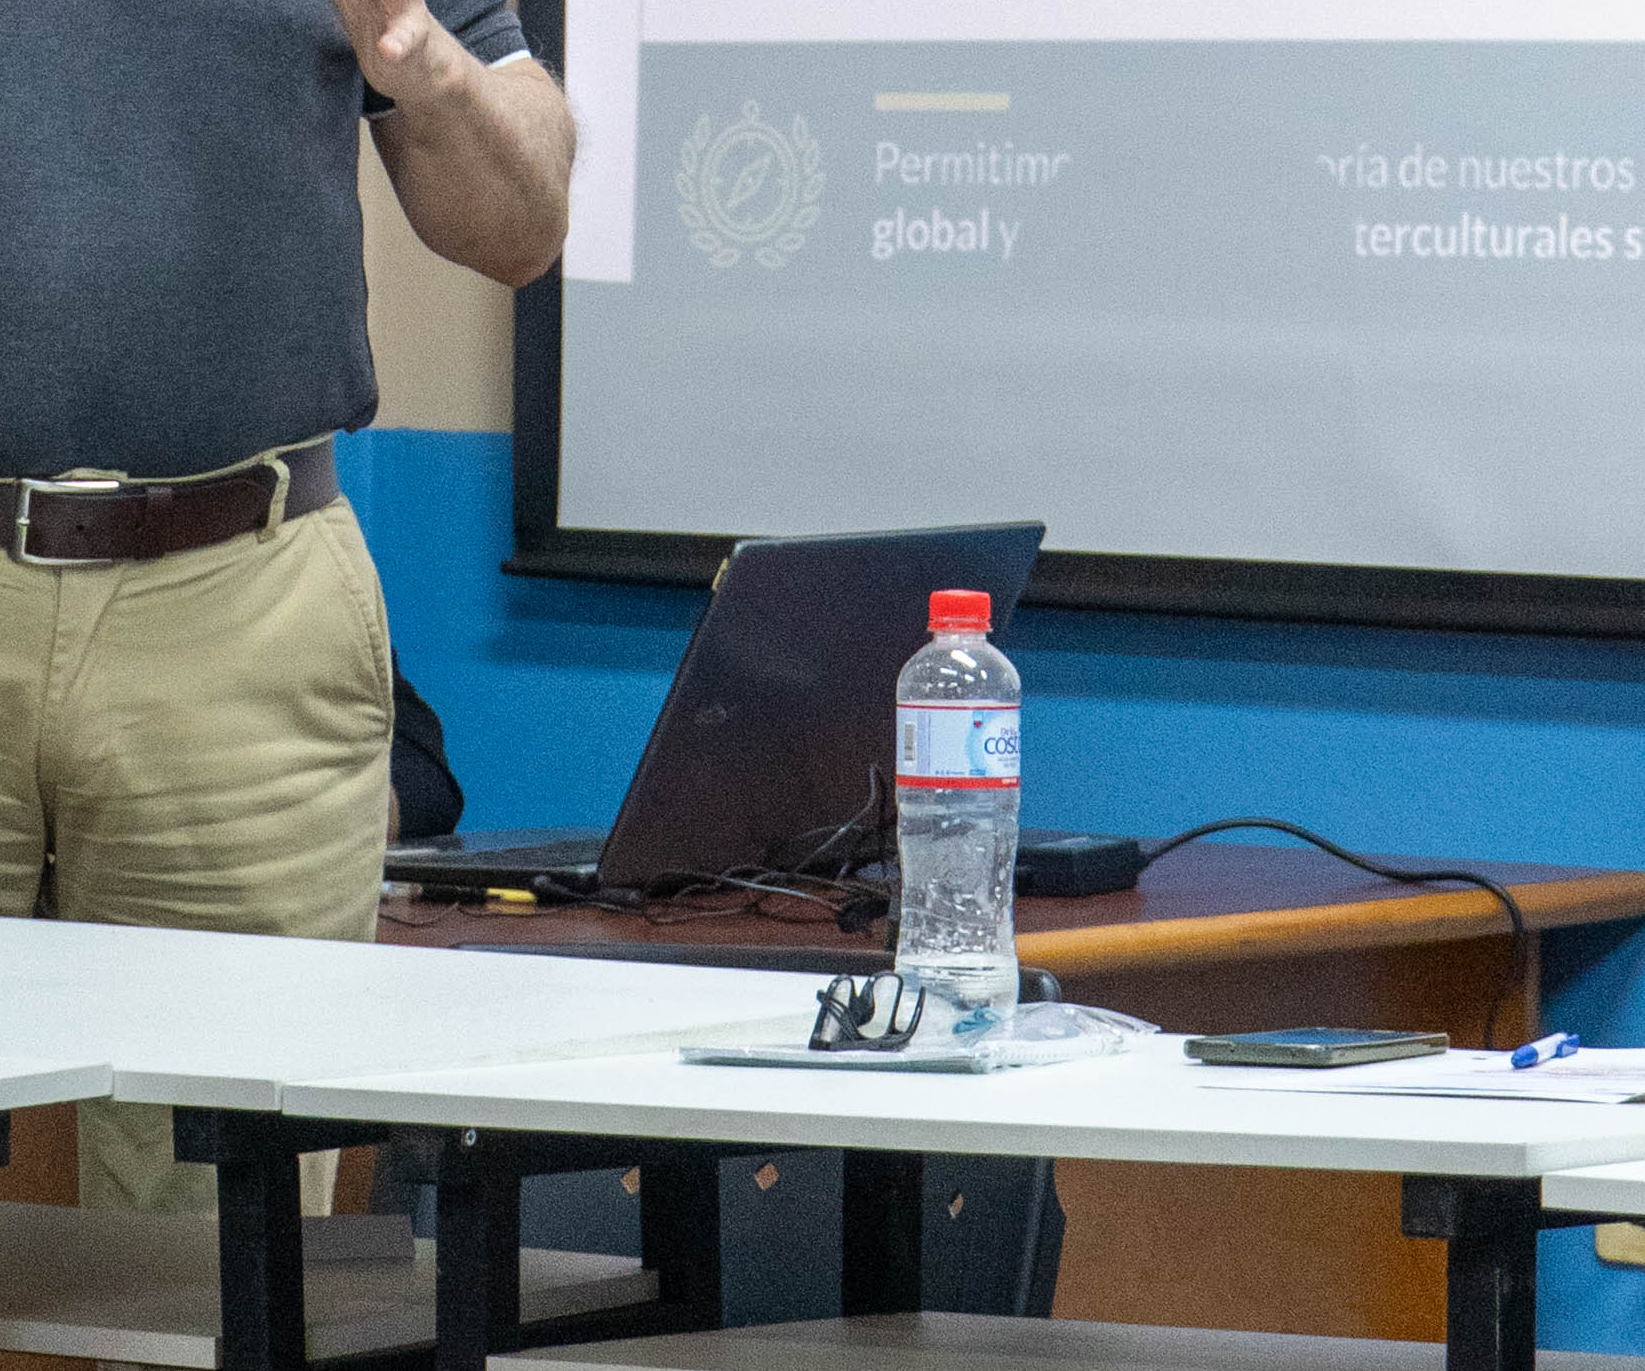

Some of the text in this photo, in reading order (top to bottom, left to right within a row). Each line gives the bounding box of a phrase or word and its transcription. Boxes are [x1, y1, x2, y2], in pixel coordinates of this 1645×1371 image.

[1399, 141, 1449, 189] de
[1459, 151, 1636, 191] nuestros
[871, 205, 990, 261] global
[998, 219, 1021, 261] y
